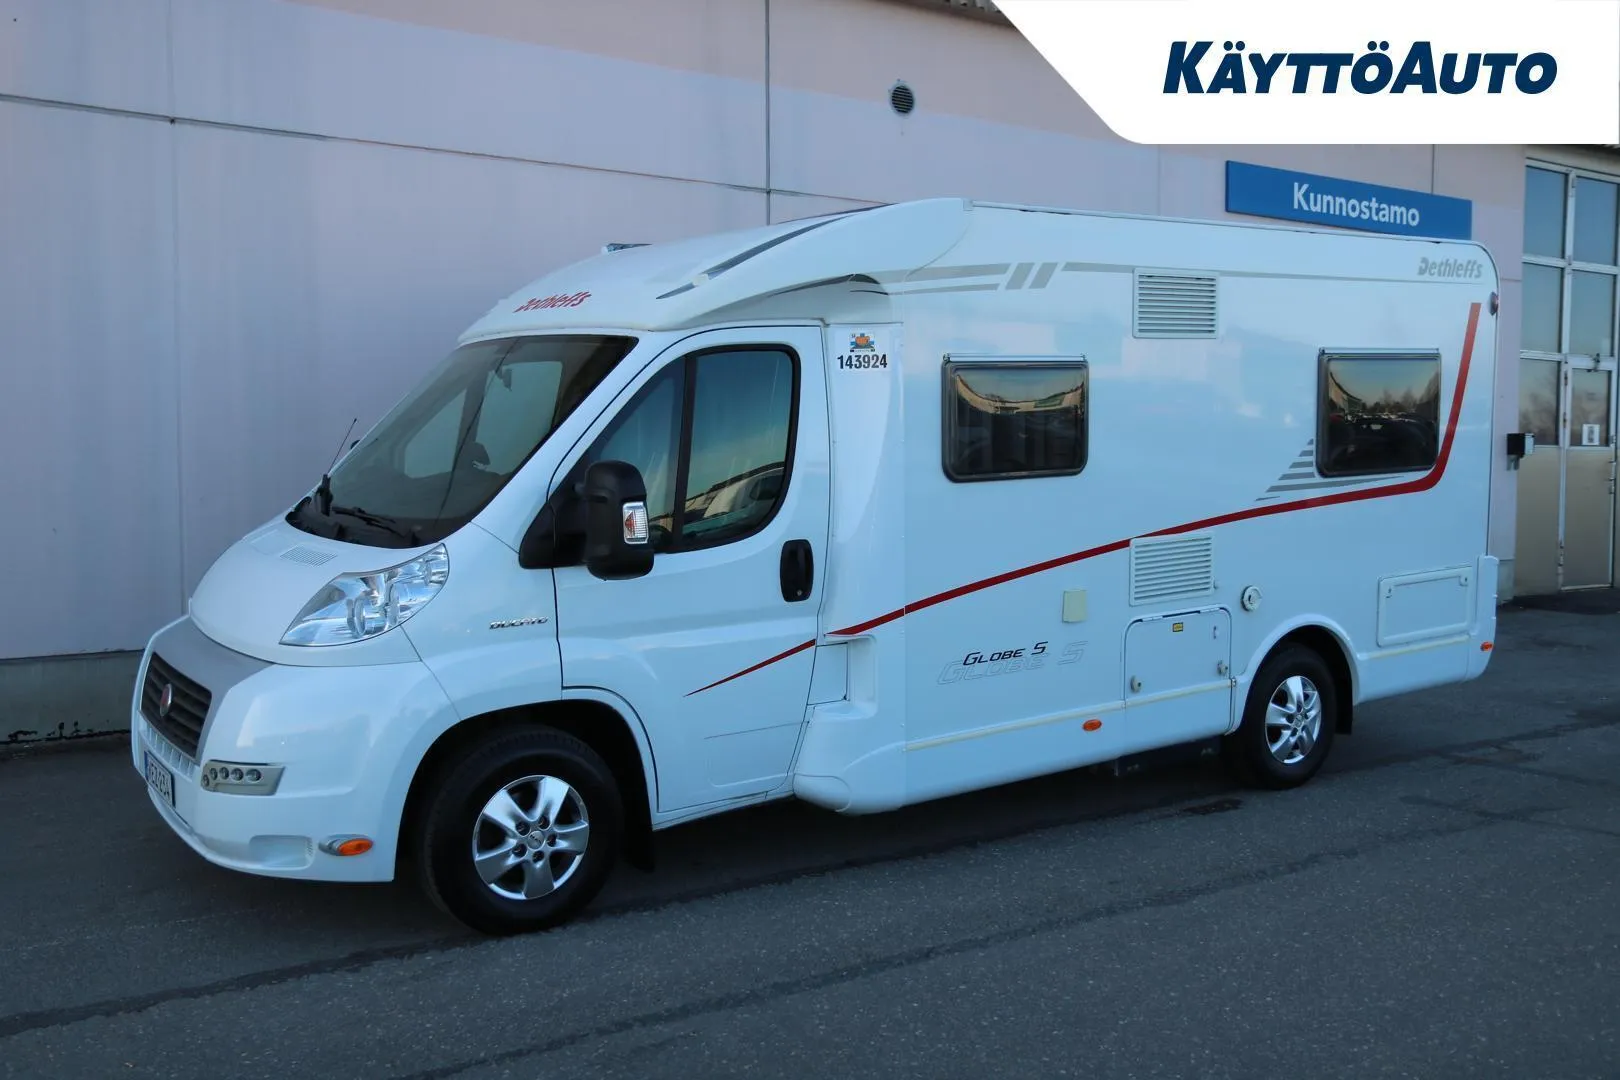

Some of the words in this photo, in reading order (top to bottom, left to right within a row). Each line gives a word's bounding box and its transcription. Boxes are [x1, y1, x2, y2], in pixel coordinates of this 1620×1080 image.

[1293, 182, 1420, 227] Kunnostamo
[1417, 257, 1483, 278] Dethleffs
[512, 291, 592, 313] Dethleffs
[837, 354, 888, 369] 143924
[1030, 641, 1049, 655] S
